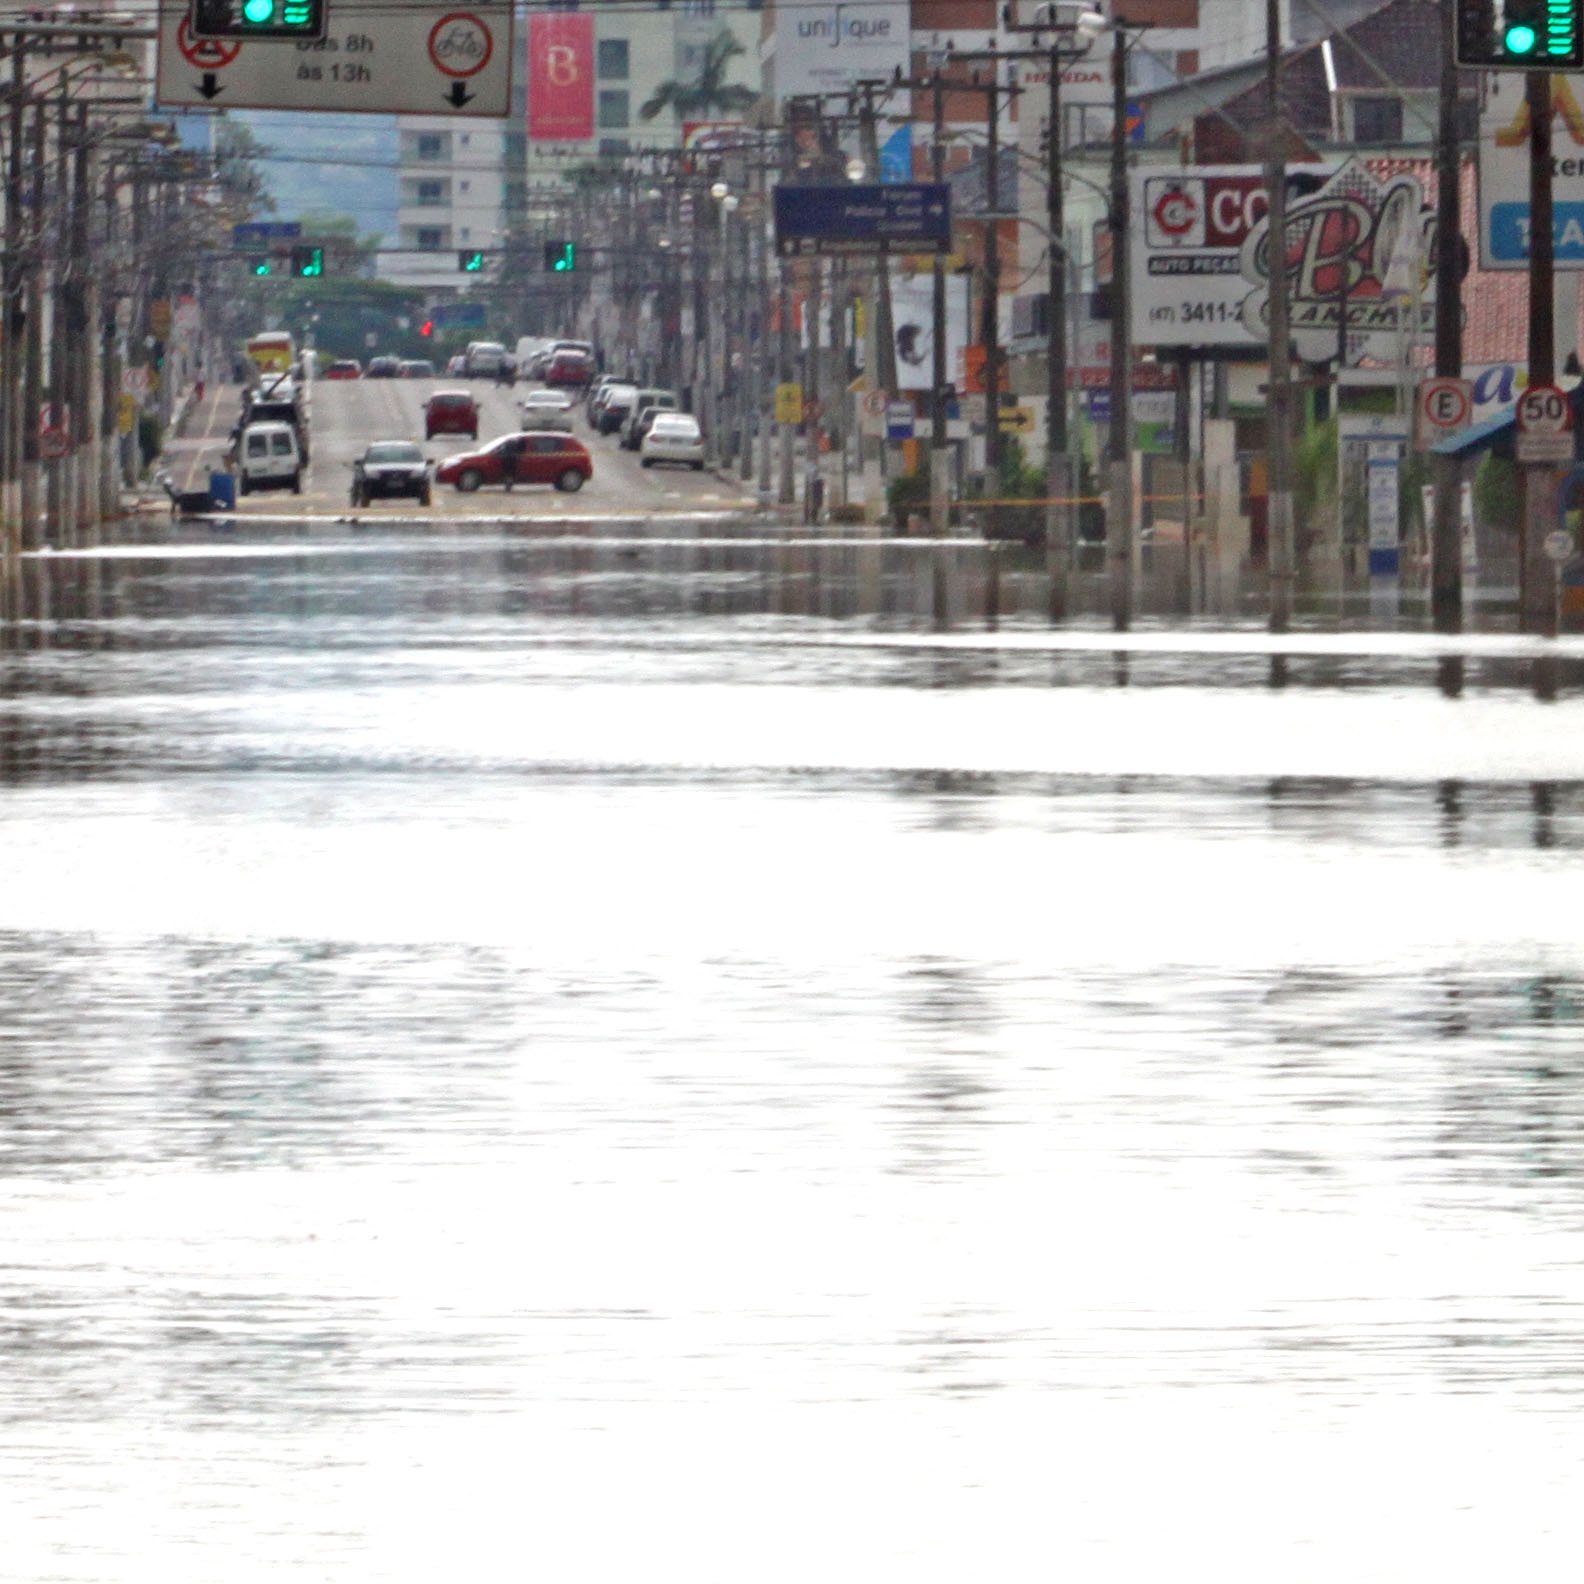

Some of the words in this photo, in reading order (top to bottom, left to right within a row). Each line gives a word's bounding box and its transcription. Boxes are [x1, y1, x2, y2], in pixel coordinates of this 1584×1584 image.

[350, 34, 374, 53] 8h
[331, 64, 371, 82] 13h
[547, 46, 579, 87] B
[1181, 303, 1243, 322] 3411-2
[1438, 392, 1452, 417] E
[1527, 395, 1563, 419] 50
